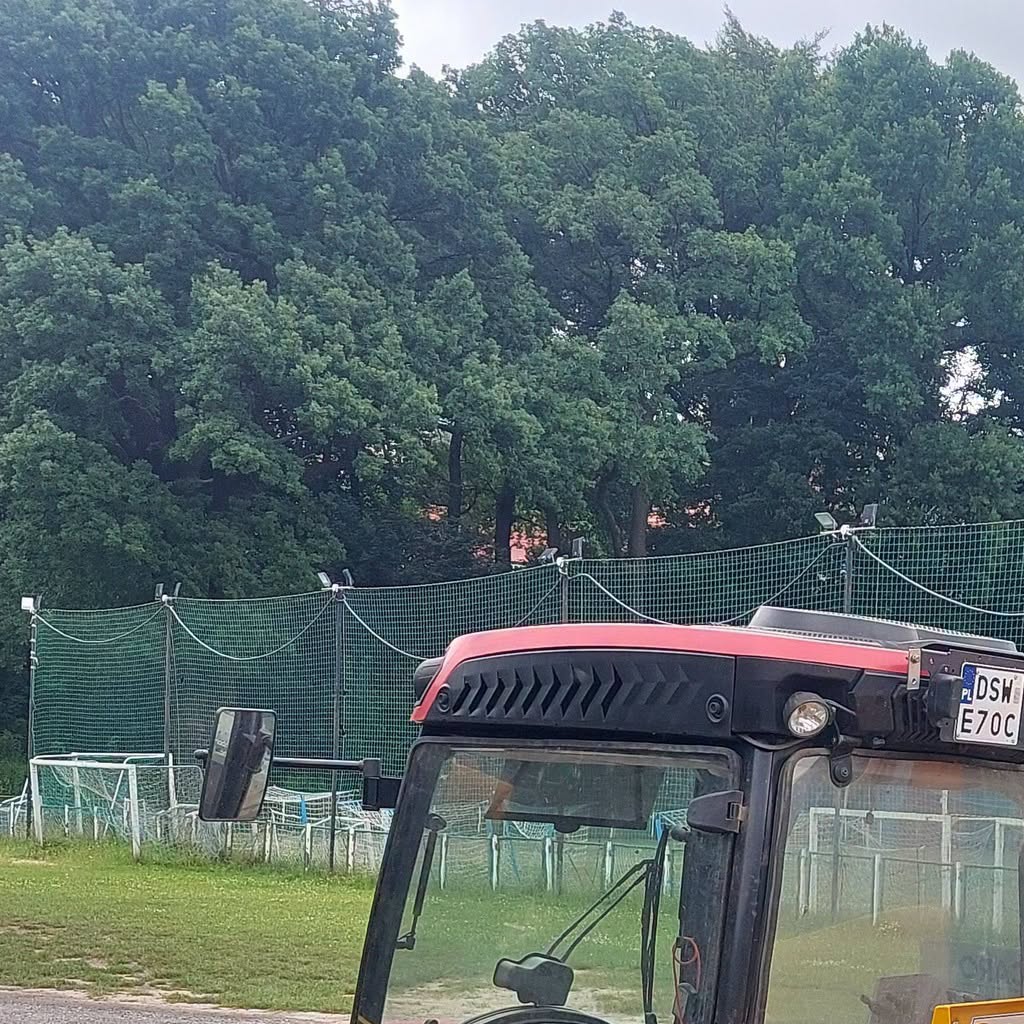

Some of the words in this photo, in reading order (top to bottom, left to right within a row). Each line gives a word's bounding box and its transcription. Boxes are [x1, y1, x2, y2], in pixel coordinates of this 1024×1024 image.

[961, 688, 972, 700] PL
[976, 674, 1014, 704] DSW
[960, 708, 1016, 738] E70C
